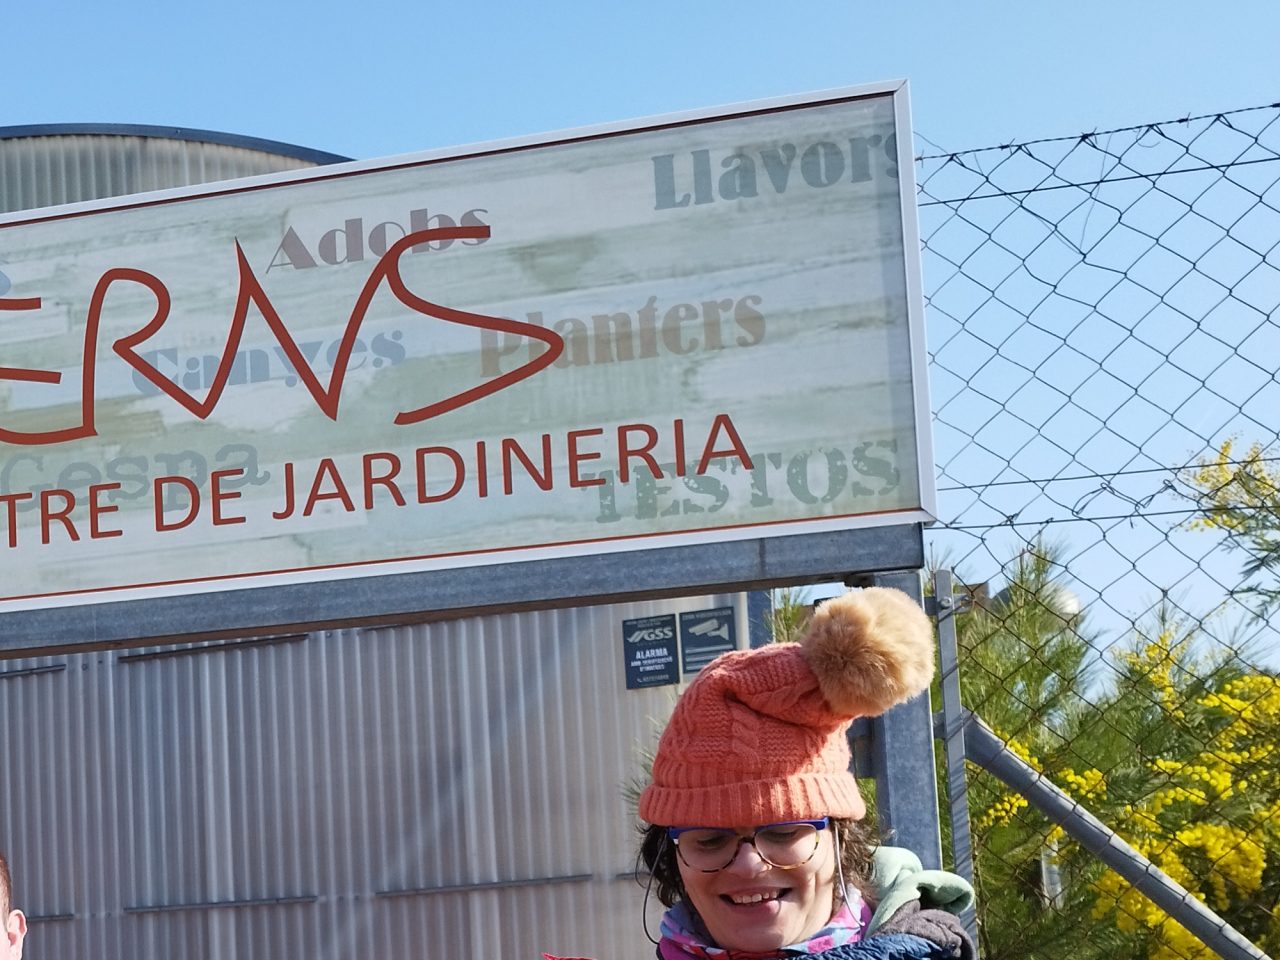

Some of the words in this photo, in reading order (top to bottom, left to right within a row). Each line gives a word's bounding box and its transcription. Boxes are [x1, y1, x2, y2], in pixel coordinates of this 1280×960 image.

[266, 207, 490, 275] Adobs
[131, 330, 407, 396] Canyes
[480, 294, 766, 379] Planters
[153, 468, 247, 533] DE
[272, 413, 755, 520] JARDINERIA
[635, 648, 668, 660] ALARMA
